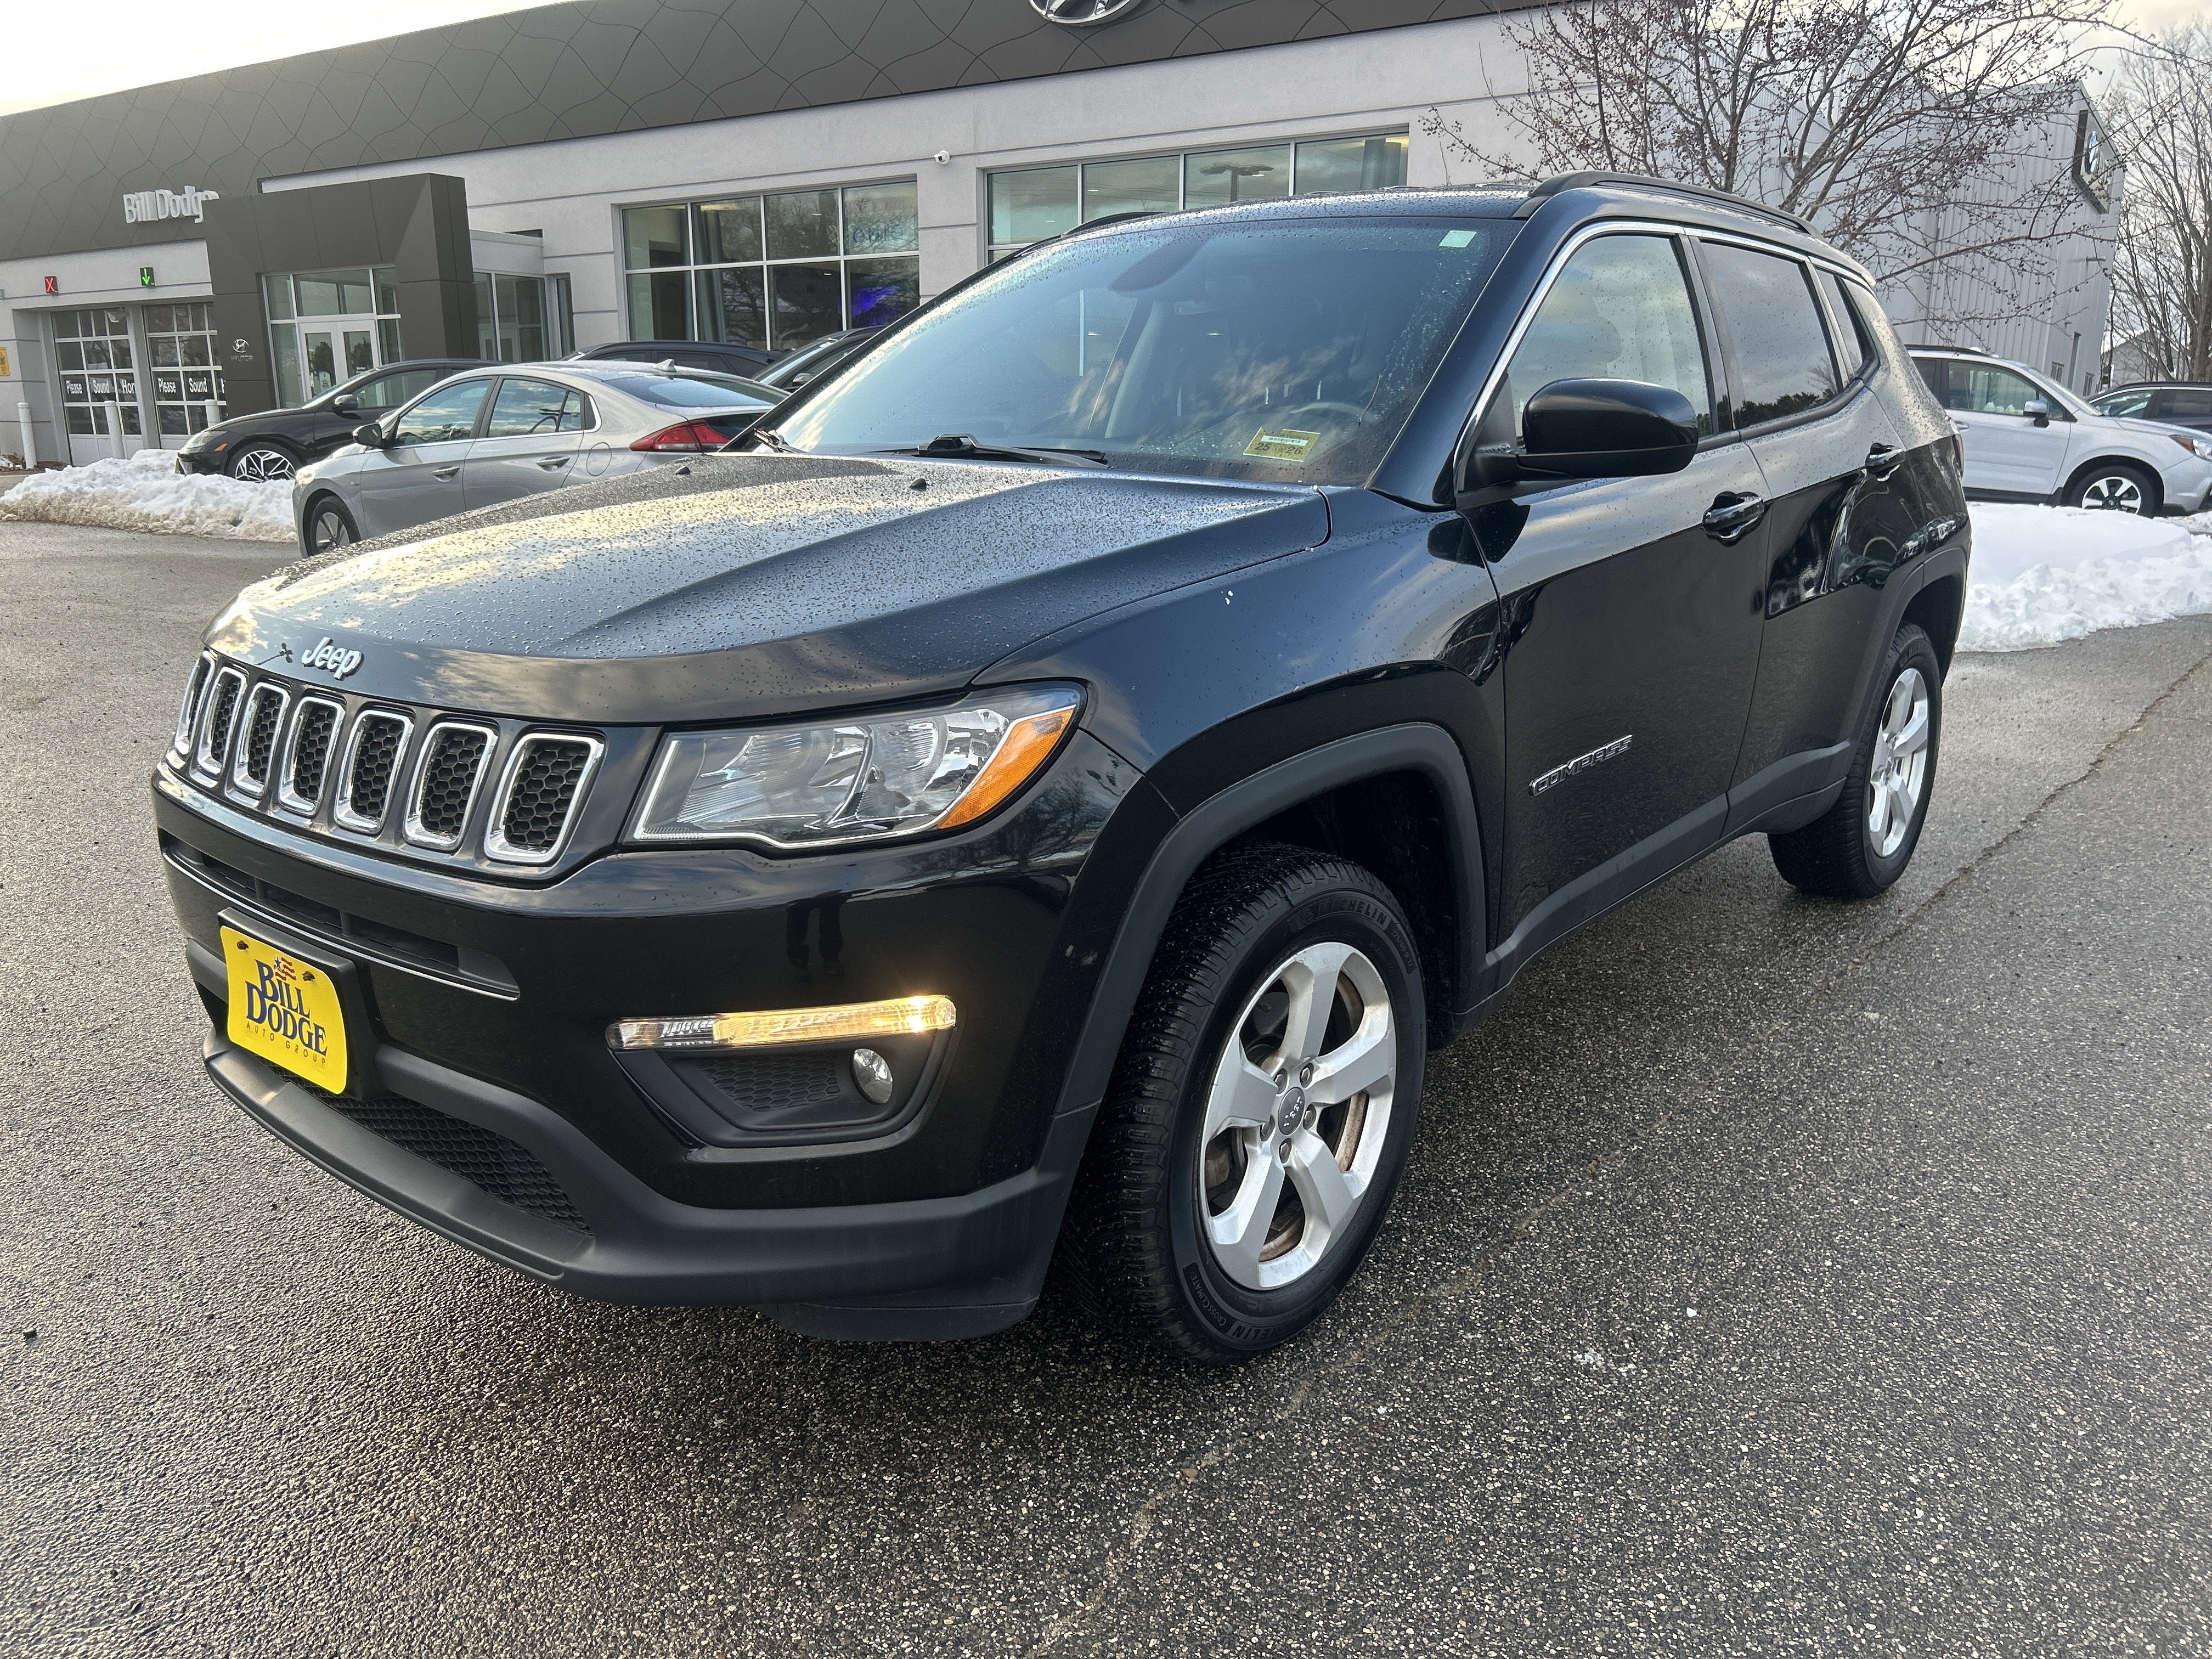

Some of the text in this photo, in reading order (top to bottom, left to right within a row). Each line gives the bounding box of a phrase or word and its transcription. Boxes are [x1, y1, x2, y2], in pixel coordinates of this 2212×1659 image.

[123, 191, 158, 223] Bill
[66, 380, 82, 394] Please
[93, 379, 110, 393] Sound
[158, 377, 176, 393] Please
[189, 377, 207, 393] Sound
[1254, 442, 1272, 451] 25
[1284, 445, 1304, 455] 26
[302, 636, 363, 680] Jeep
[1529, 735, 1633, 796] COMPASS
[1318, 898, 1388, 927] MICHELIN
[256, 959, 310, 1018] BILL
[245, 980, 328, 1056] DODGE
[246, 1023, 326, 1066] AUTO GROUP
